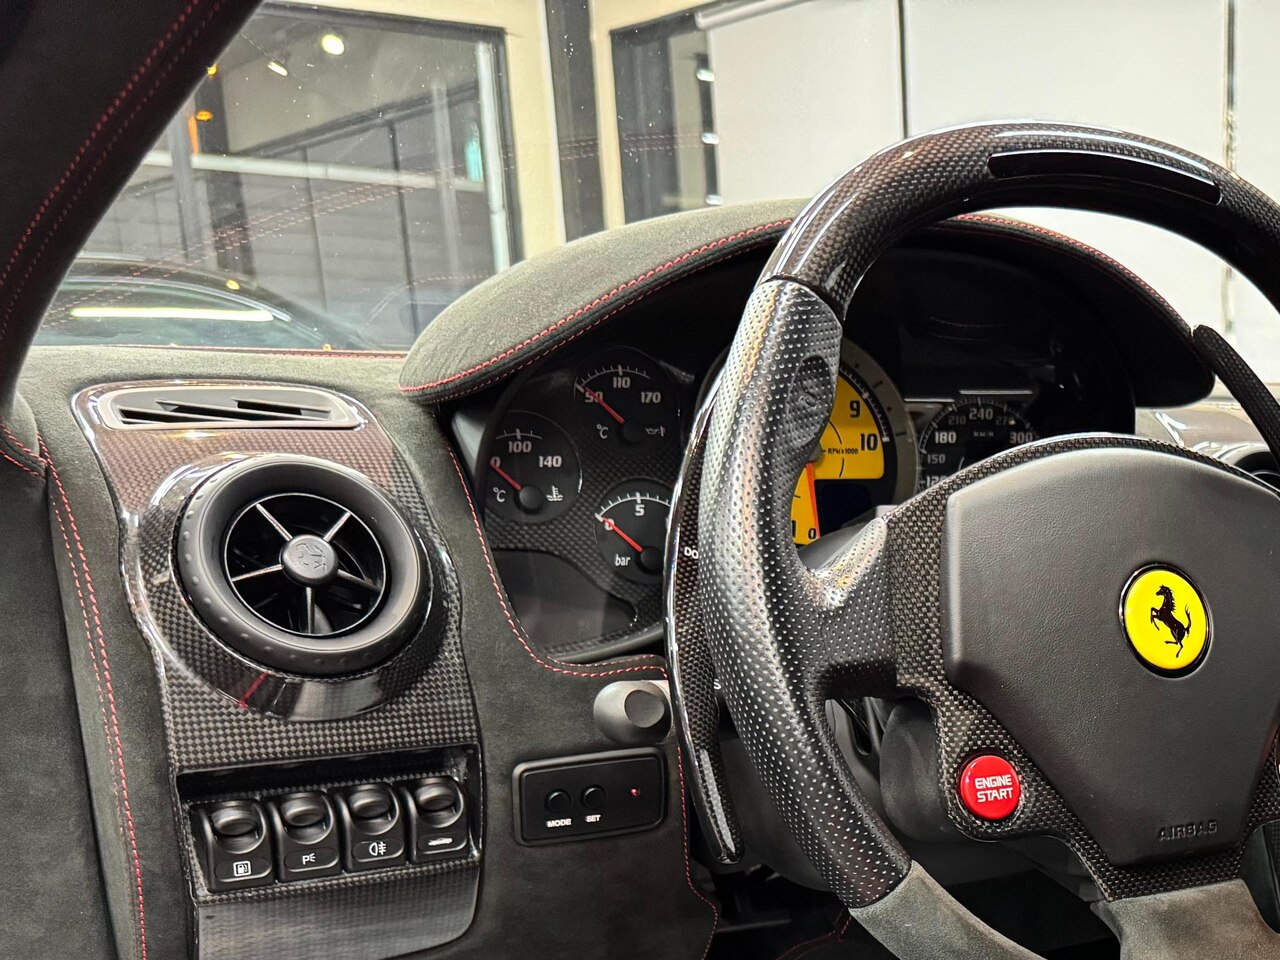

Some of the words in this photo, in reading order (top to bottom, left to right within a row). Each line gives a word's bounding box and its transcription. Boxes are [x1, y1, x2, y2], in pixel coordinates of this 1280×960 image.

[613, 376, 631, 388] 110
[640, 392, 662, 404] 170
[850, 400, 860, 418] 9
[968, 408, 994, 420] 240
[860, 433, 878, 451] 10
[934, 432, 957, 444] 180
[1010, 432, 1034, 444] 300
[508, 440, 532, 453] 100
[538, 456, 562, 468] 140
[927, 454, 946, 464] 150
[635, 504, 645, 516] 5
[808, 528, 816, 540] 0
[615, 554, 630, 566] bar
[974, 774, 1012, 790] ENGINE
[976, 787, 1014, 802] START
[546, 818, 572, 828] MODE
